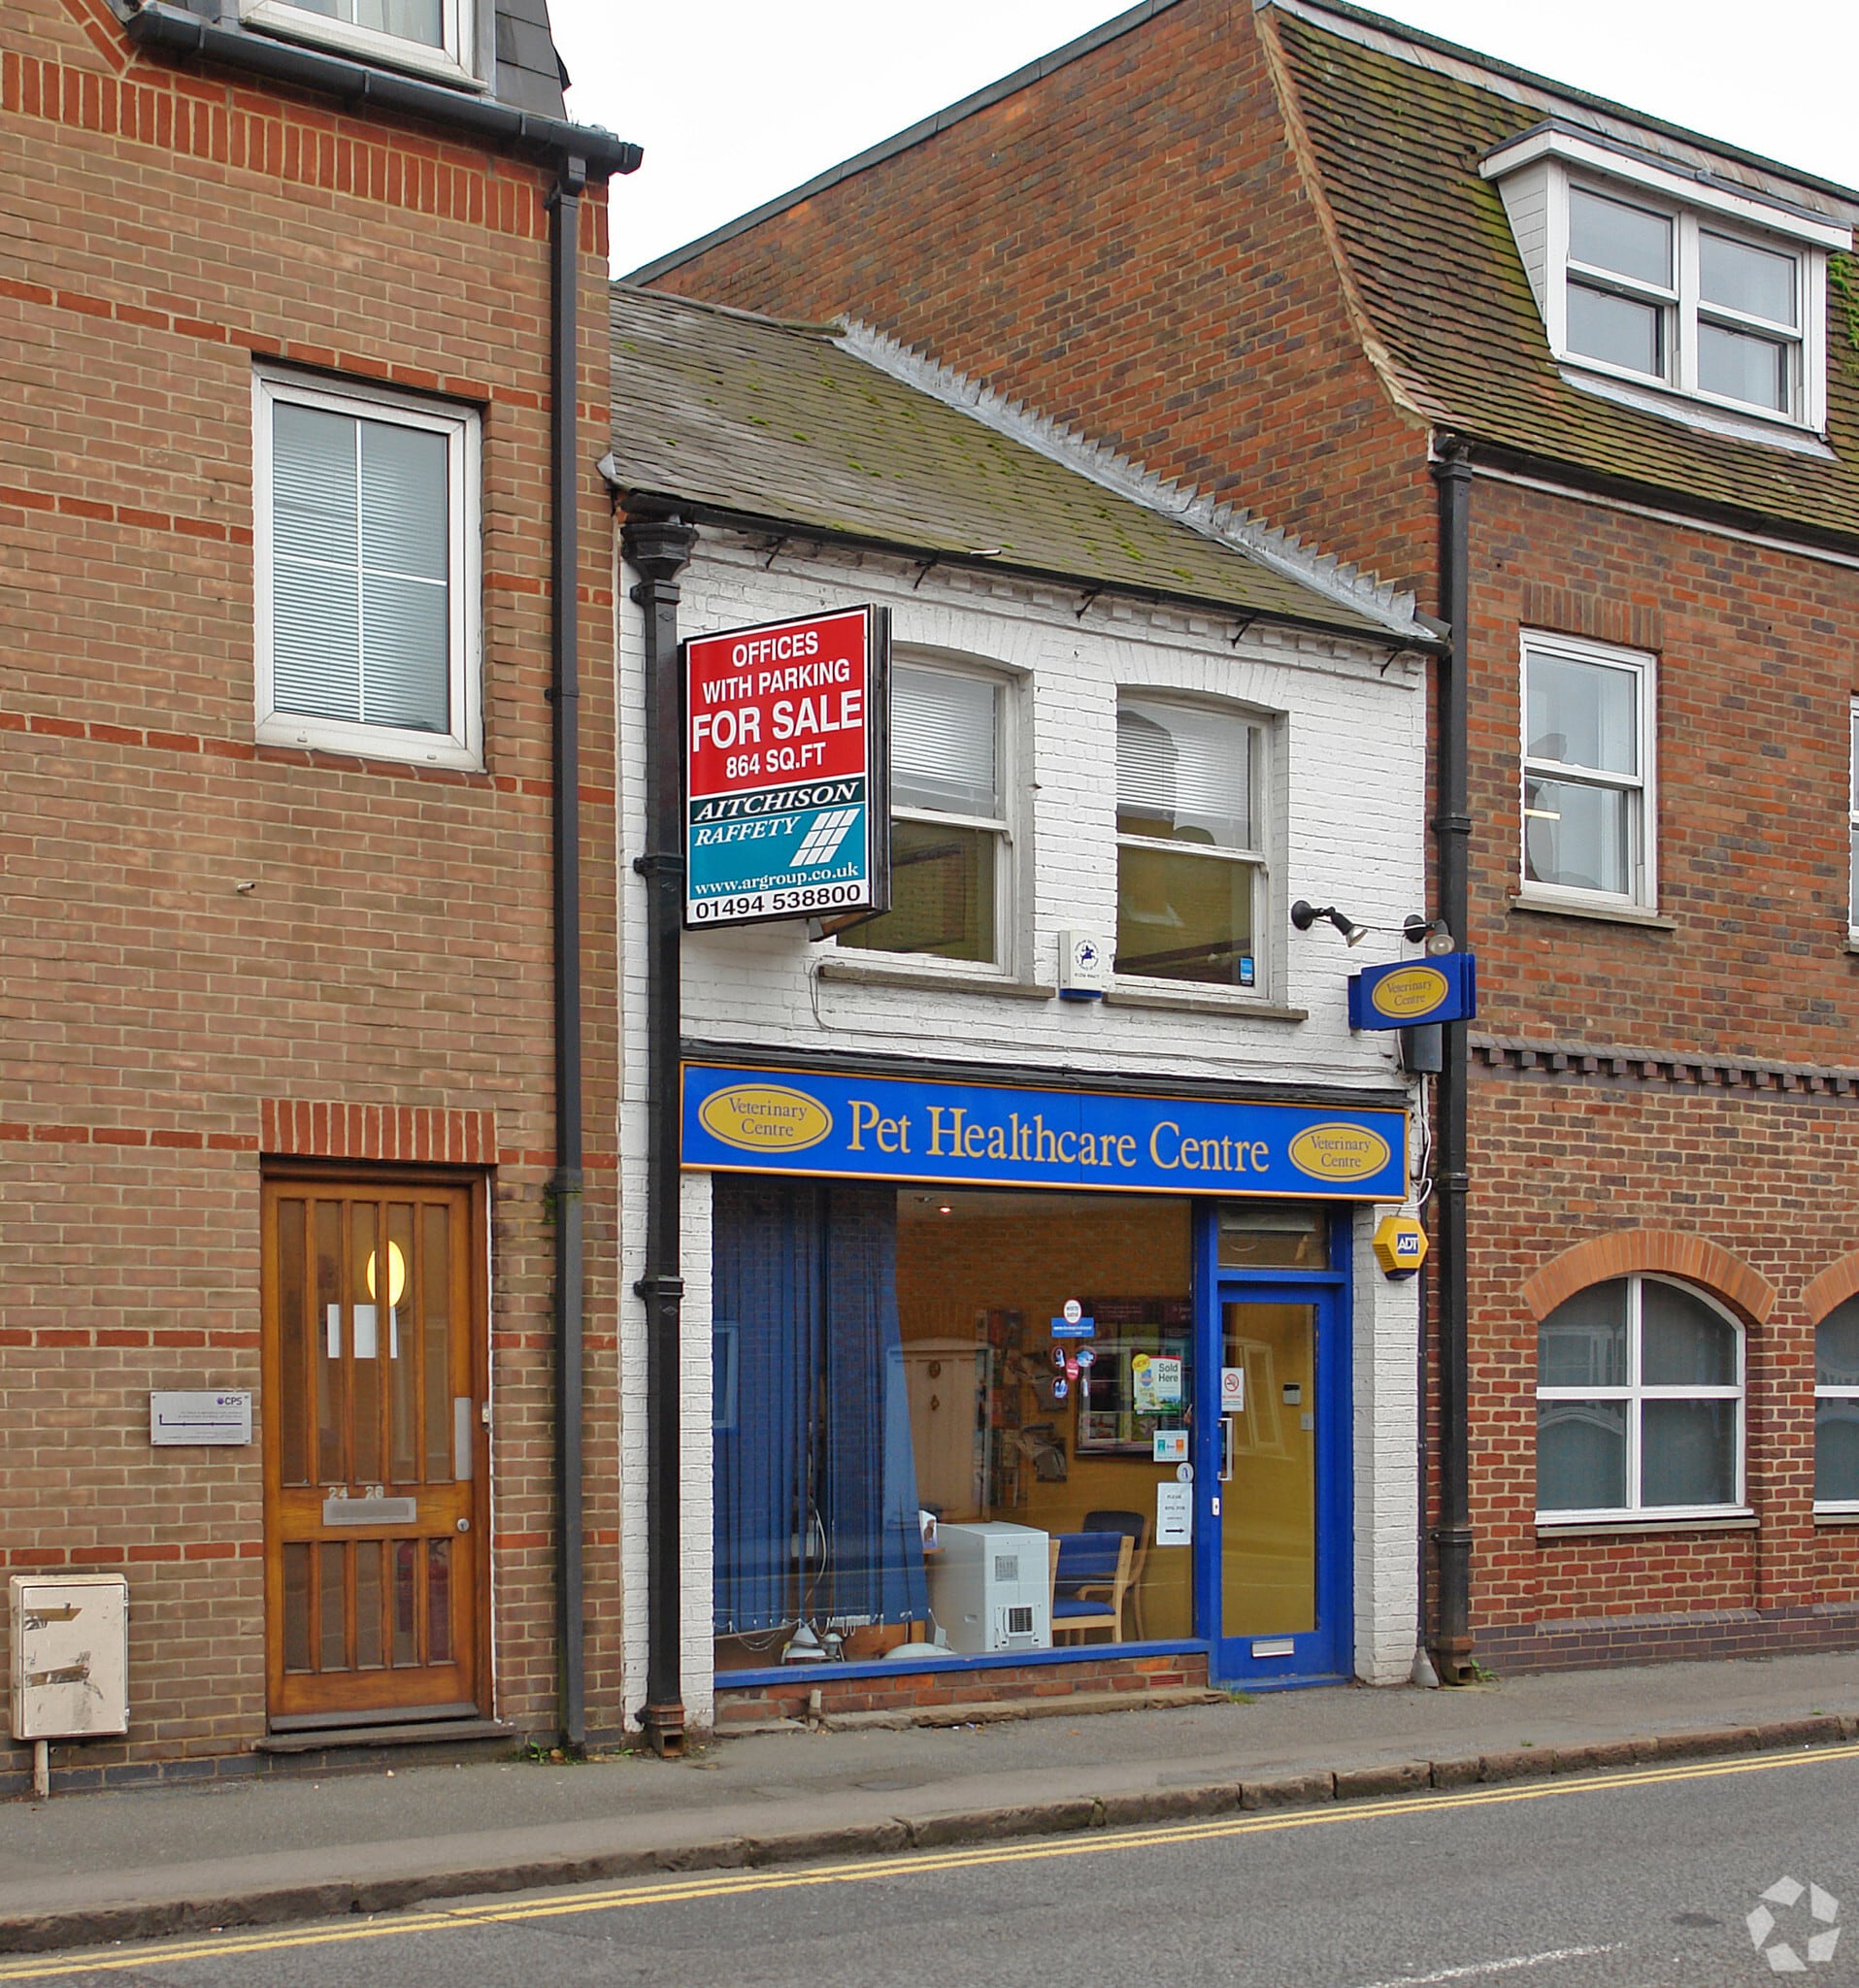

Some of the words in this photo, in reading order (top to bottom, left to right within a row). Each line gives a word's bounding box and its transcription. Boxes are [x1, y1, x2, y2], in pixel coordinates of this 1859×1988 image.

[732, 631, 818, 667] OFFICES
[702, 675, 752, 705] WITH
[758, 658, 850, 693] PARKING
[692, 707, 761, 753] FOR
[773, 689, 863, 740] SALE
[726, 753, 760, 779] 864
[766, 742, 826, 773] SQ.FT
[694, 782, 859, 822] AITCHISON
[694, 815, 802, 846] RAFFETY
[695, 861, 859, 895] www.argroup.co.uk
[696, 895, 765, 919] 01494
[773, 884, 861, 910] 538800
[1386, 977, 1433, 994] Veterinary
[1394, 992, 1426, 1007] Centre
[728, 1097, 808, 1121] Veterinary
[741, 1118, 794, 1138] Centre
[847, 1100, 912, 1154] Pet
[926, 1106, 1136, 1168] Healthcare
[1149, 1121, 1270, 1173] Centre
[1311, 1135, 1372, 1153] Veterinary
[1321, 1152, 1362, 1169] Centre
[1398, 1237, 1418, 1250] ADT
[1158, 1363, 1178, 1373] Sold
[1158, 1374, 1178, 1382] Here
[224, 1397, 243, 1406] CPS
[328, 1486, 348, 1500] 24
